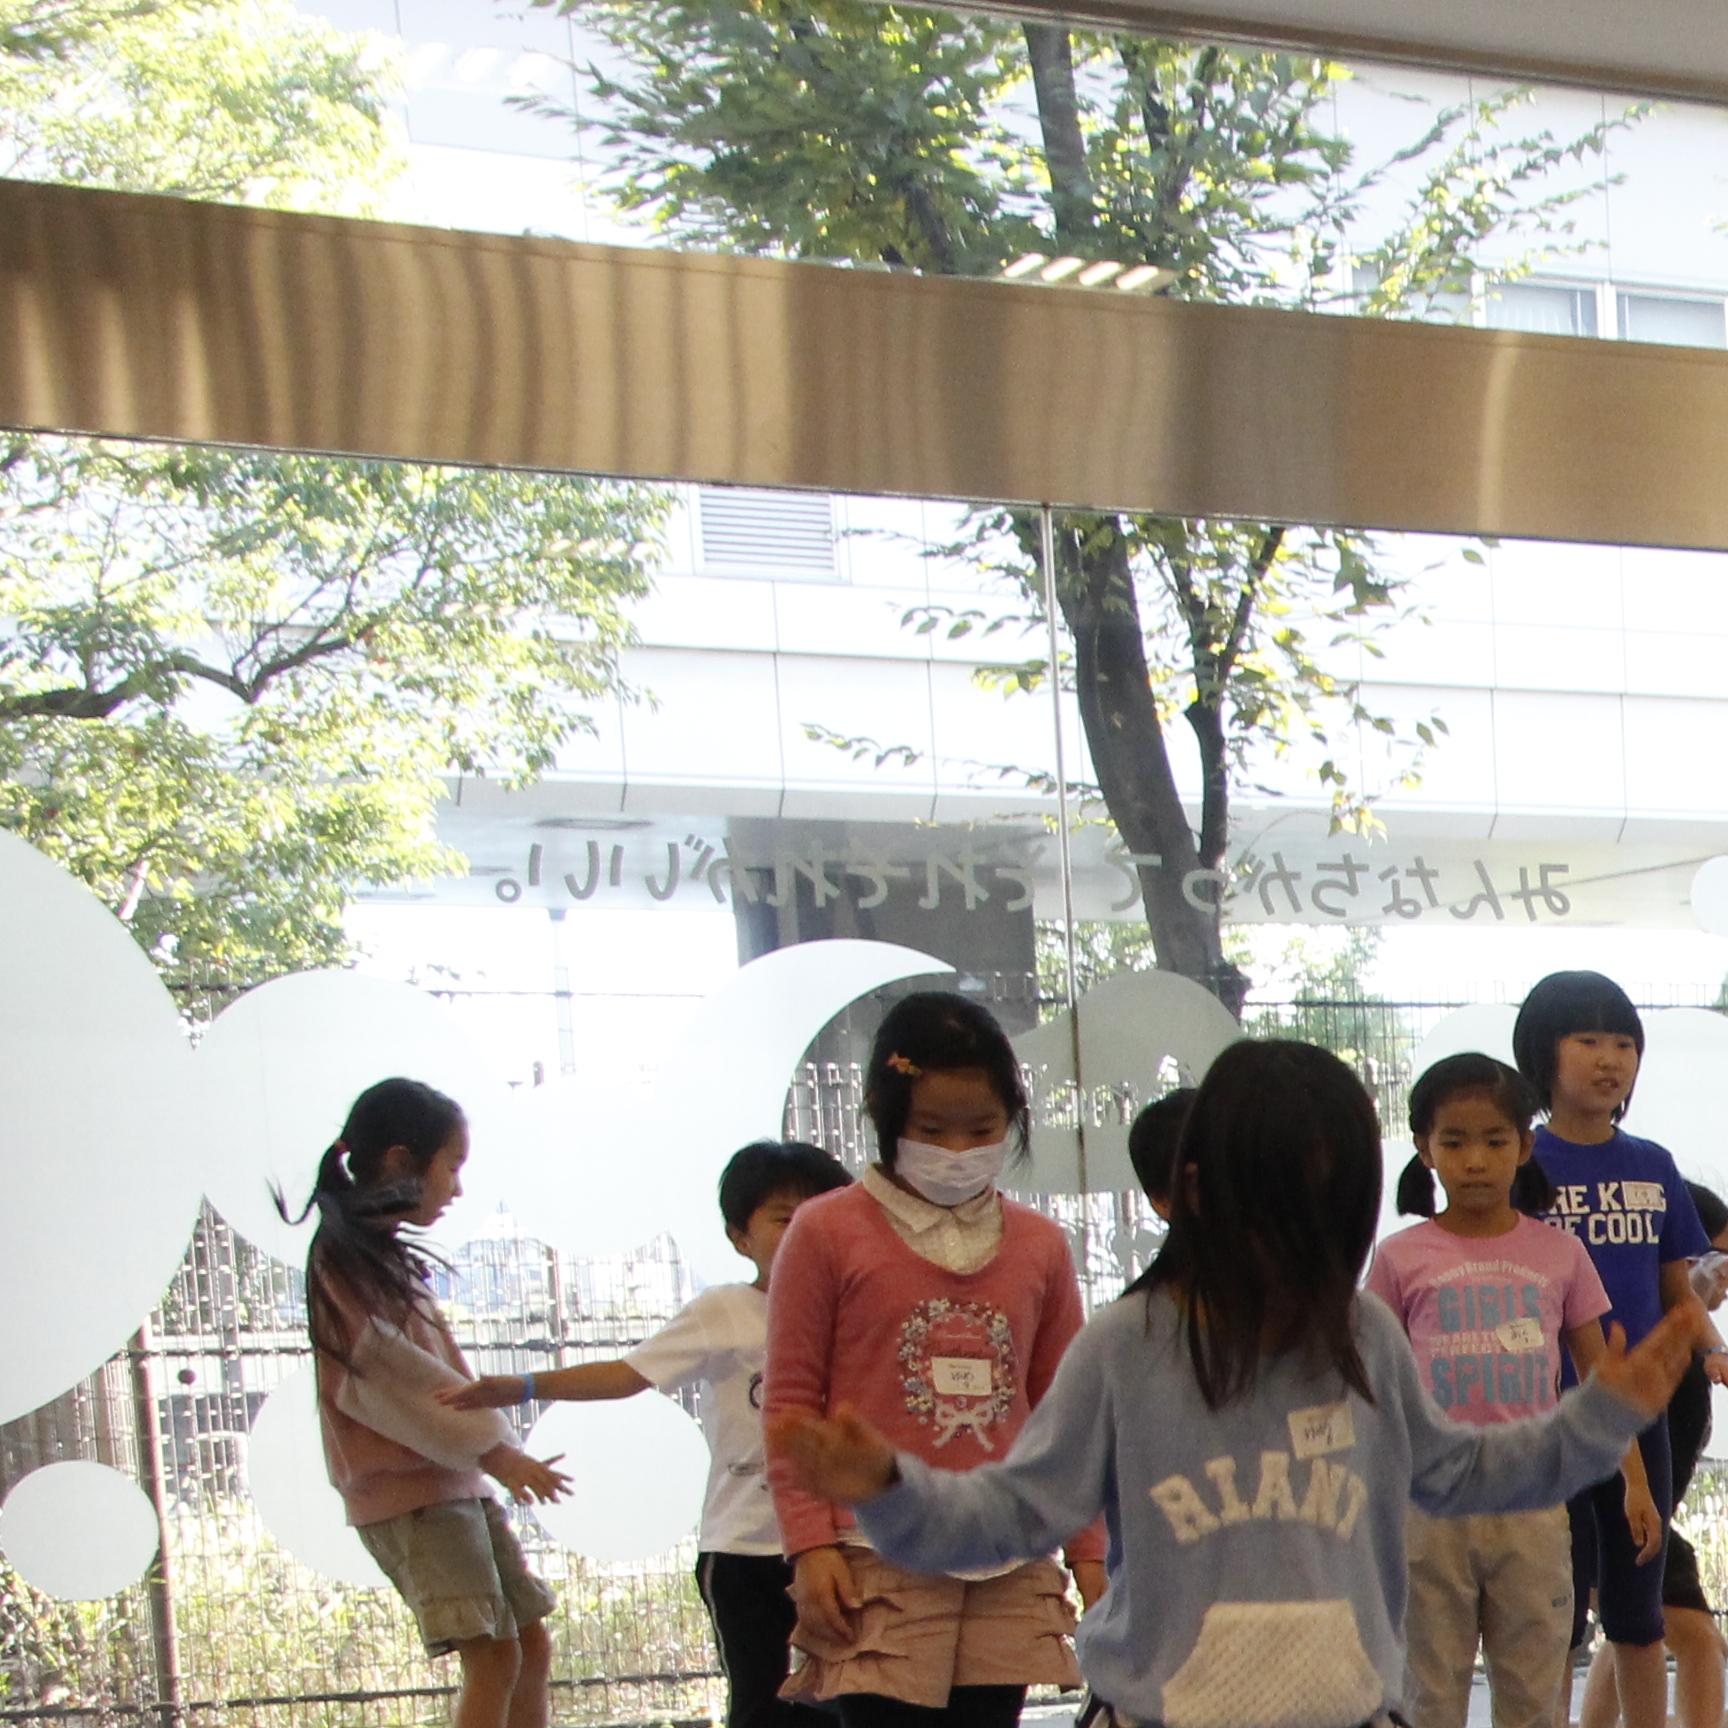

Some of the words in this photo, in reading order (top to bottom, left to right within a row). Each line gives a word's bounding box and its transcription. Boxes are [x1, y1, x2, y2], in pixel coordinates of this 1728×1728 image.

[1548, 1185, 1590, 1214] HE
[1588, 1212, 1659, 1245] COOL
[1431, 1355, 1548, 1408] SPIRIT
